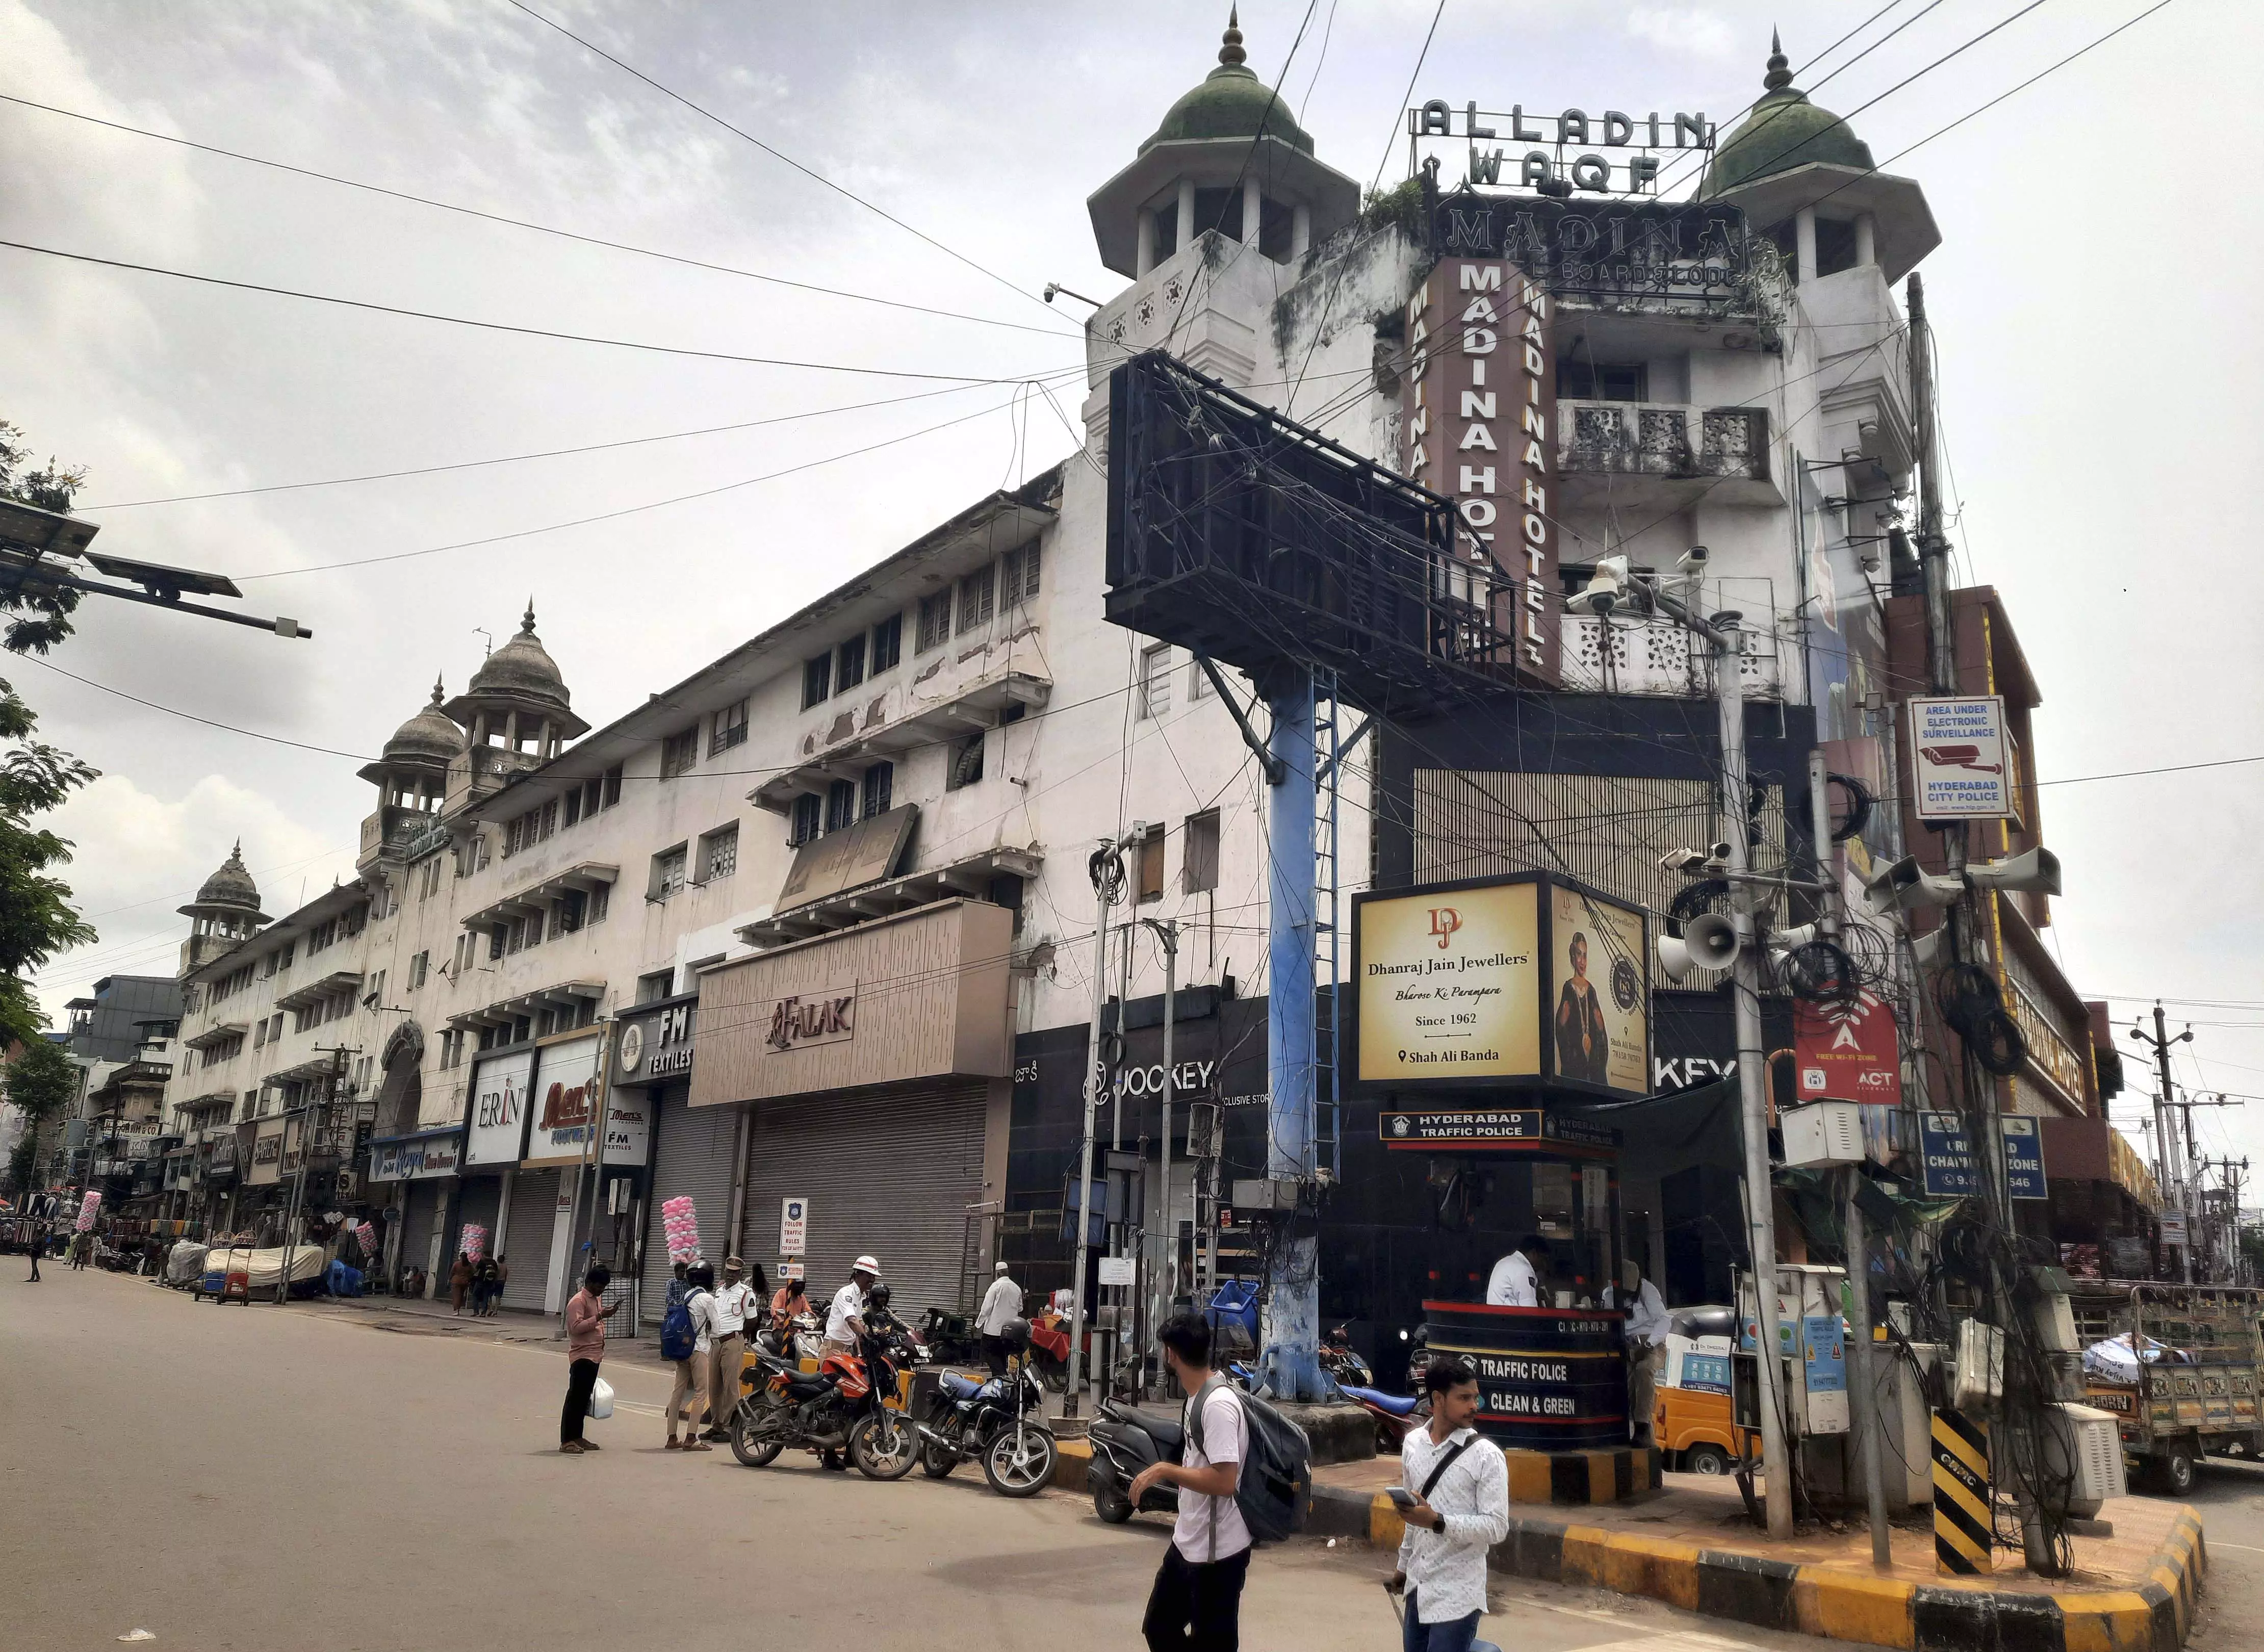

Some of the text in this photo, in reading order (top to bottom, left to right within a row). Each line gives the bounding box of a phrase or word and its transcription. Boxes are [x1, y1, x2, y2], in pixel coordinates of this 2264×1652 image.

[1421, 99, 1706, 148] ALLADIN
[1469, 146, 1660, 194] WAQF
[1446, 209, 1738, 259] MADINA
[1561, 264, 1646, 283] BOARD
[1459, 264, 1501, 452] MADINA
[1409, 281, 1428, 478] MADINA
[1522, 279, 1546, 474] MADINA
[1524, 478, 1546, 645] HOTEL
[1925, 705, 1987, 715] AREA UNDER
[1927, 716, 1987, 727] ELECTRONIC
[1922, 728, 1995, 739] SURVEILLANCE
[1927, 781, 1998, 791] HYDERABAD
[1927, 792, 1999, 802] CITY POLICE
[1368, 952, 1528, 976] Dhanraj Jain Jewellers
[1434, 987, 1449, 1000] Ki
[658, 1005, 687, 1048] FM
[1415, 1013, 1477, 1026] Since 1962
[648, 1048, 692, 1073] TEXTILES
[1409, 1049, 1499, 1064] Shah Ali Banda
[1859, 1072, 1893, 1086] ACT
[1419, 1114, 1522, 1125] HYDERABAD
[608, 1131, 628, 1144] FM
[1420, 1126, 1523, 1138] TRAFFIC POLICE
[1480, 1358, 1528, 1379] TRAFFIC
[1490, 1392, 1575, 1415] CLEAN & GREEN
